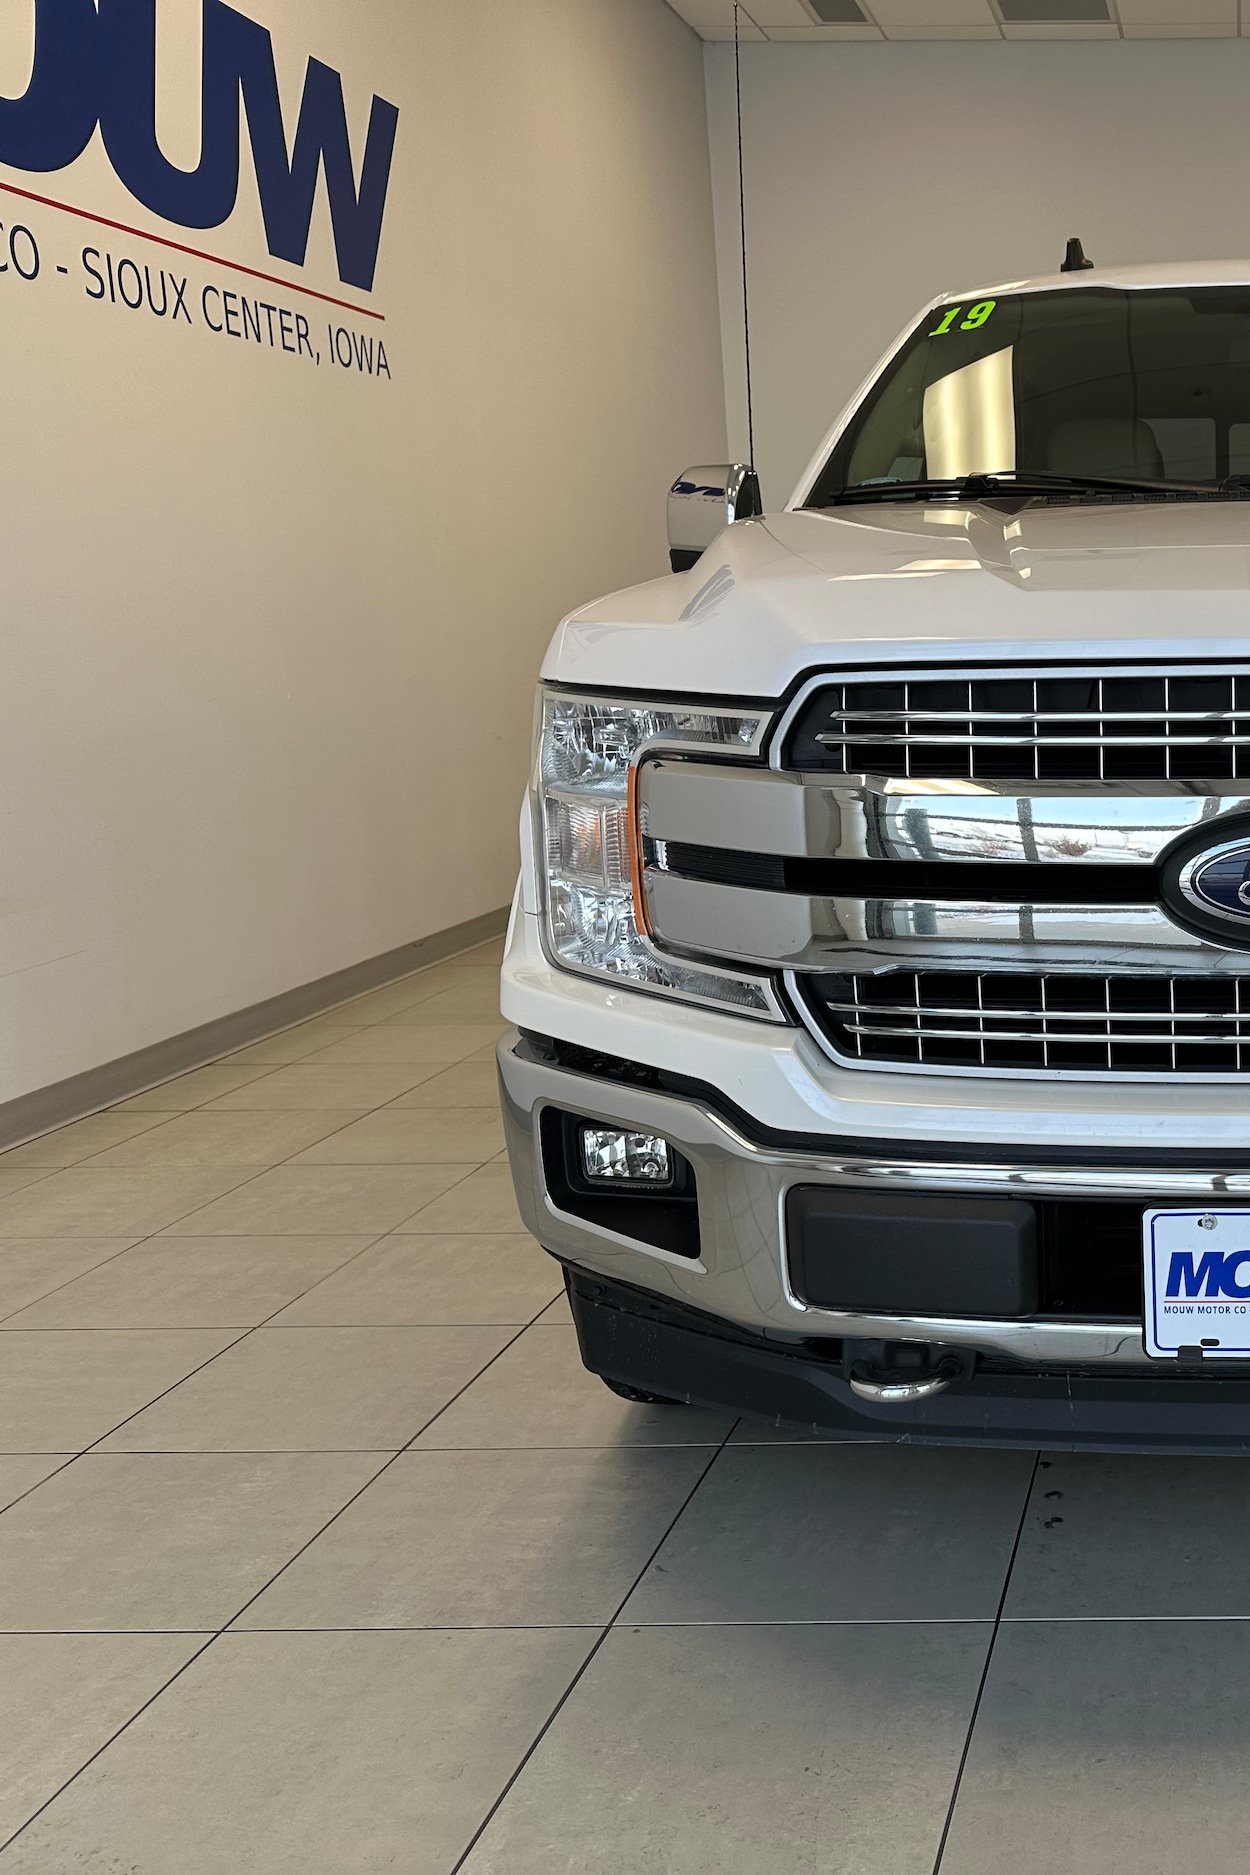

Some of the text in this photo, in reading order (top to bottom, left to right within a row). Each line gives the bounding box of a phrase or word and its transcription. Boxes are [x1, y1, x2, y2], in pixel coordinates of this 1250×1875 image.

[0, 222, 40, 281] O
[81, 246, 193, 325] SIOUX
[201, 285, 321, 366] CENTER,
[327, 324, 391, 380] IOWA
[928, 300, 997, 337] 19
[1164, 1306, 1194, 1314] MOUW
[1197, 1306, 1231, 1314] MOTOR
[1234, 1306, 1247, 1314] CO
